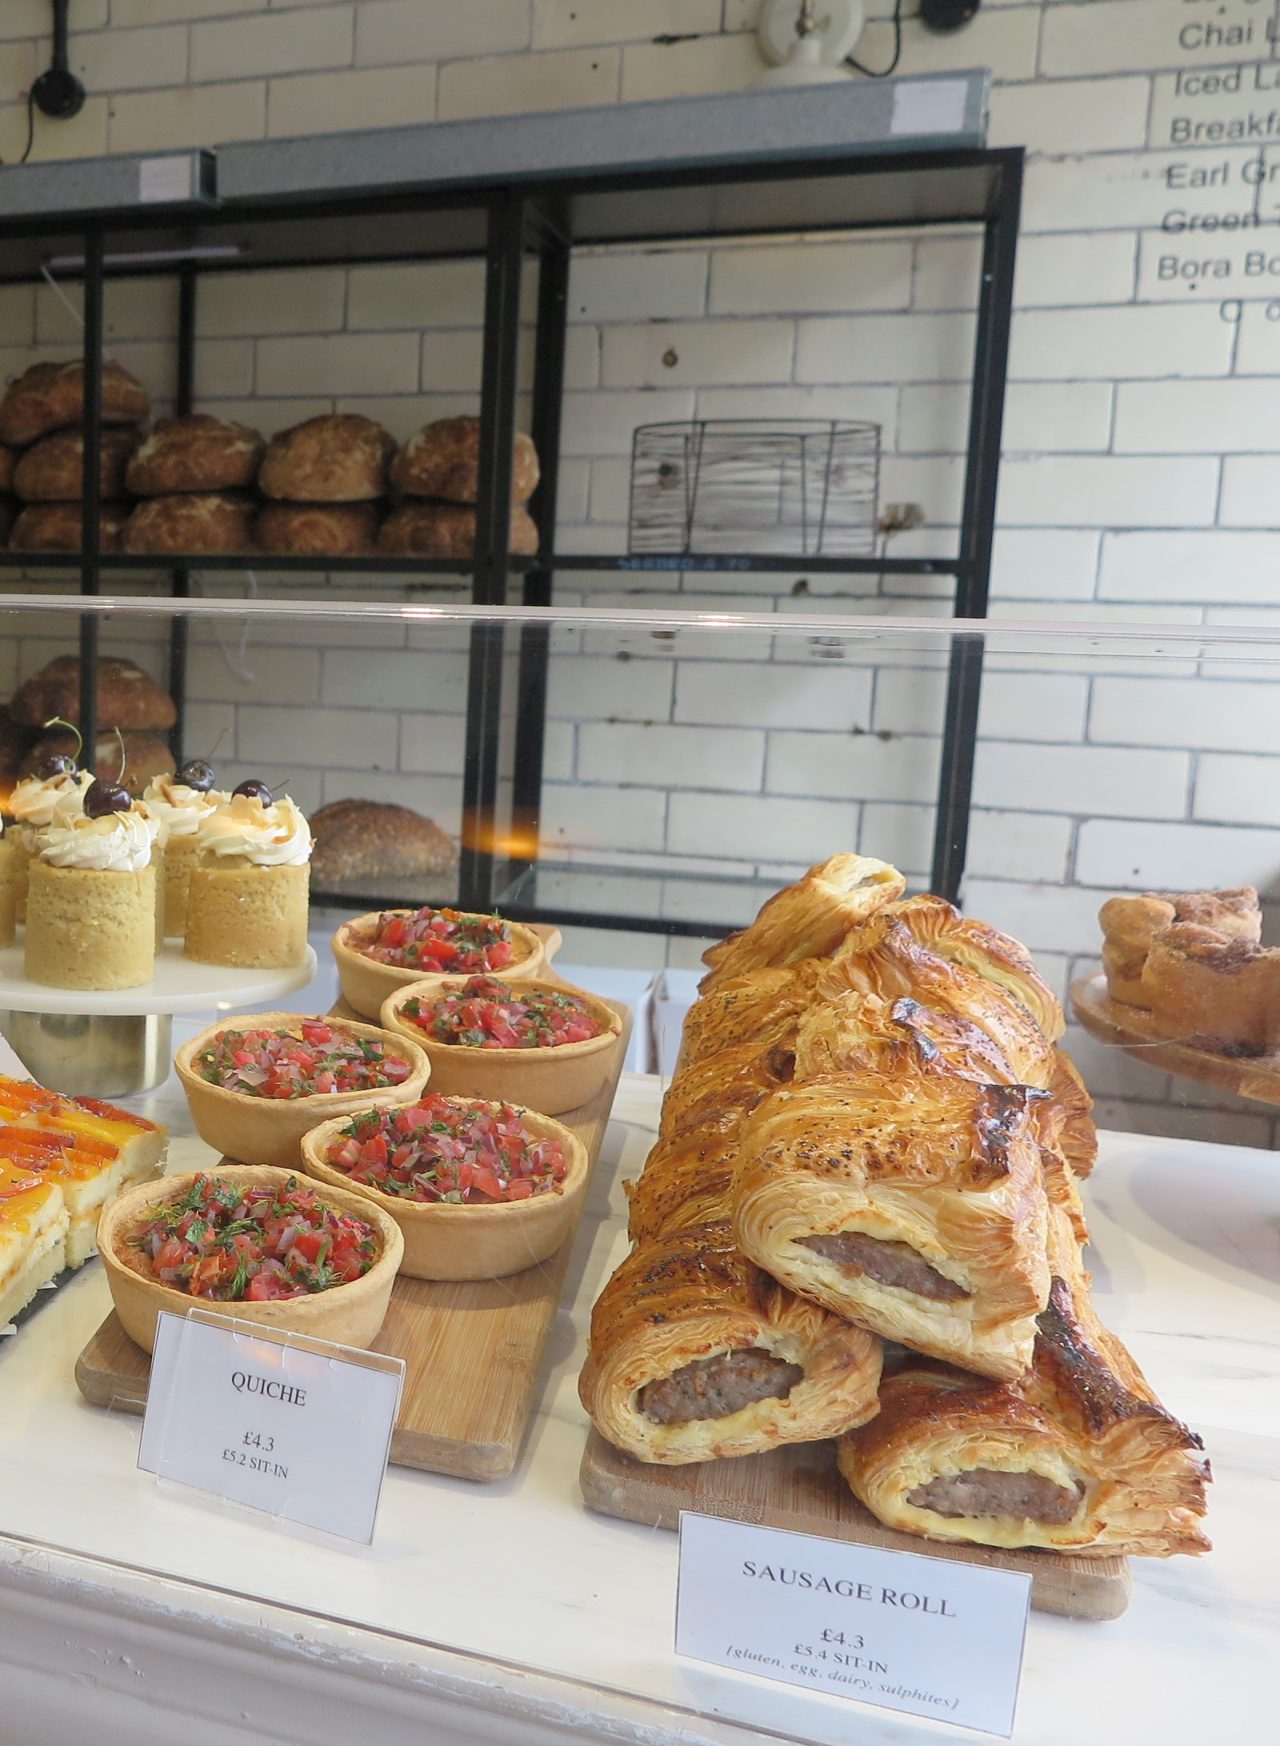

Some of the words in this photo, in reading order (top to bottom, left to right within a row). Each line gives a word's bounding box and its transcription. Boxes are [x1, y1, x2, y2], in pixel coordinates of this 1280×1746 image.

[1179, 18, 1252, 50] Chai
[1175, 63, 1242, 97] Iced
[1170, 111, 1280, 143] Breakf
[1166, 160, 1229, 189] Earl
[1161, 208, 1261, 235] Green
[1158, 255, 1231, 281] Bora
[231, 1370, 307, 1407] QUICHE
[242, 1430, 275, 1452] £4.3
[221, 1448, 246, 1466] £5.2
[249, 1457, 289, 1479] SIT-IN
[742, 1560, 873, 1602] SAUSAGE
[880, 1588, 957, 1618] ROLL
[820, 1627, 865, 1649] £4.3
[793, 1643, 828, 1662] £5.4
[833, 1652, 888, 1675] SIT-IN
[725, 1644, 785, 1669] [gluten,
[789, 1663, 823, 1680] egg,
[827, 1668, 874, 1691] dairy,
[878, 1680, 960, 1710] sulphites]
